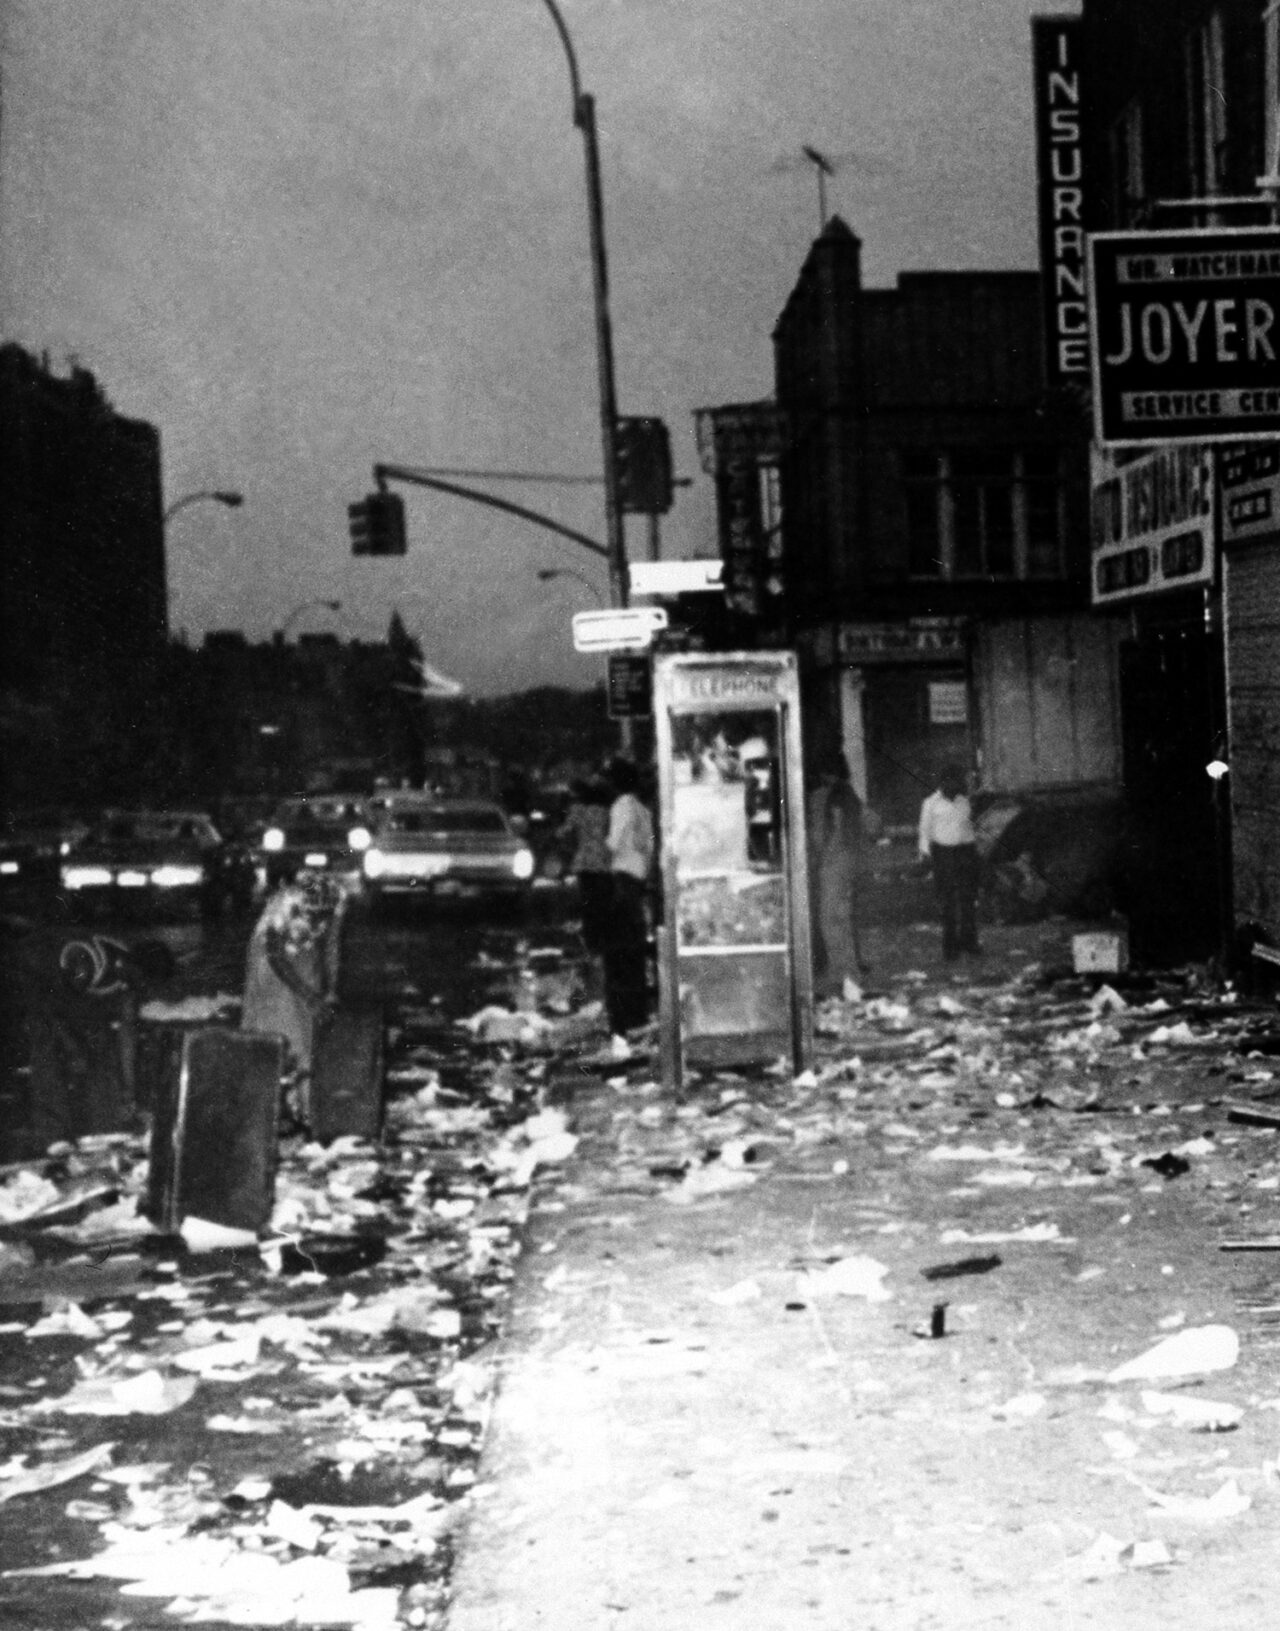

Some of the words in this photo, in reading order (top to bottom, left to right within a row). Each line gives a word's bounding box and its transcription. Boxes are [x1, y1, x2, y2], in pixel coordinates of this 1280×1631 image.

[1048, 33, 1088, 372] INSURANCE
[1131, 390, 1222, 418] SERVICE
[680, 671, 778, 699] ELEPHONE
